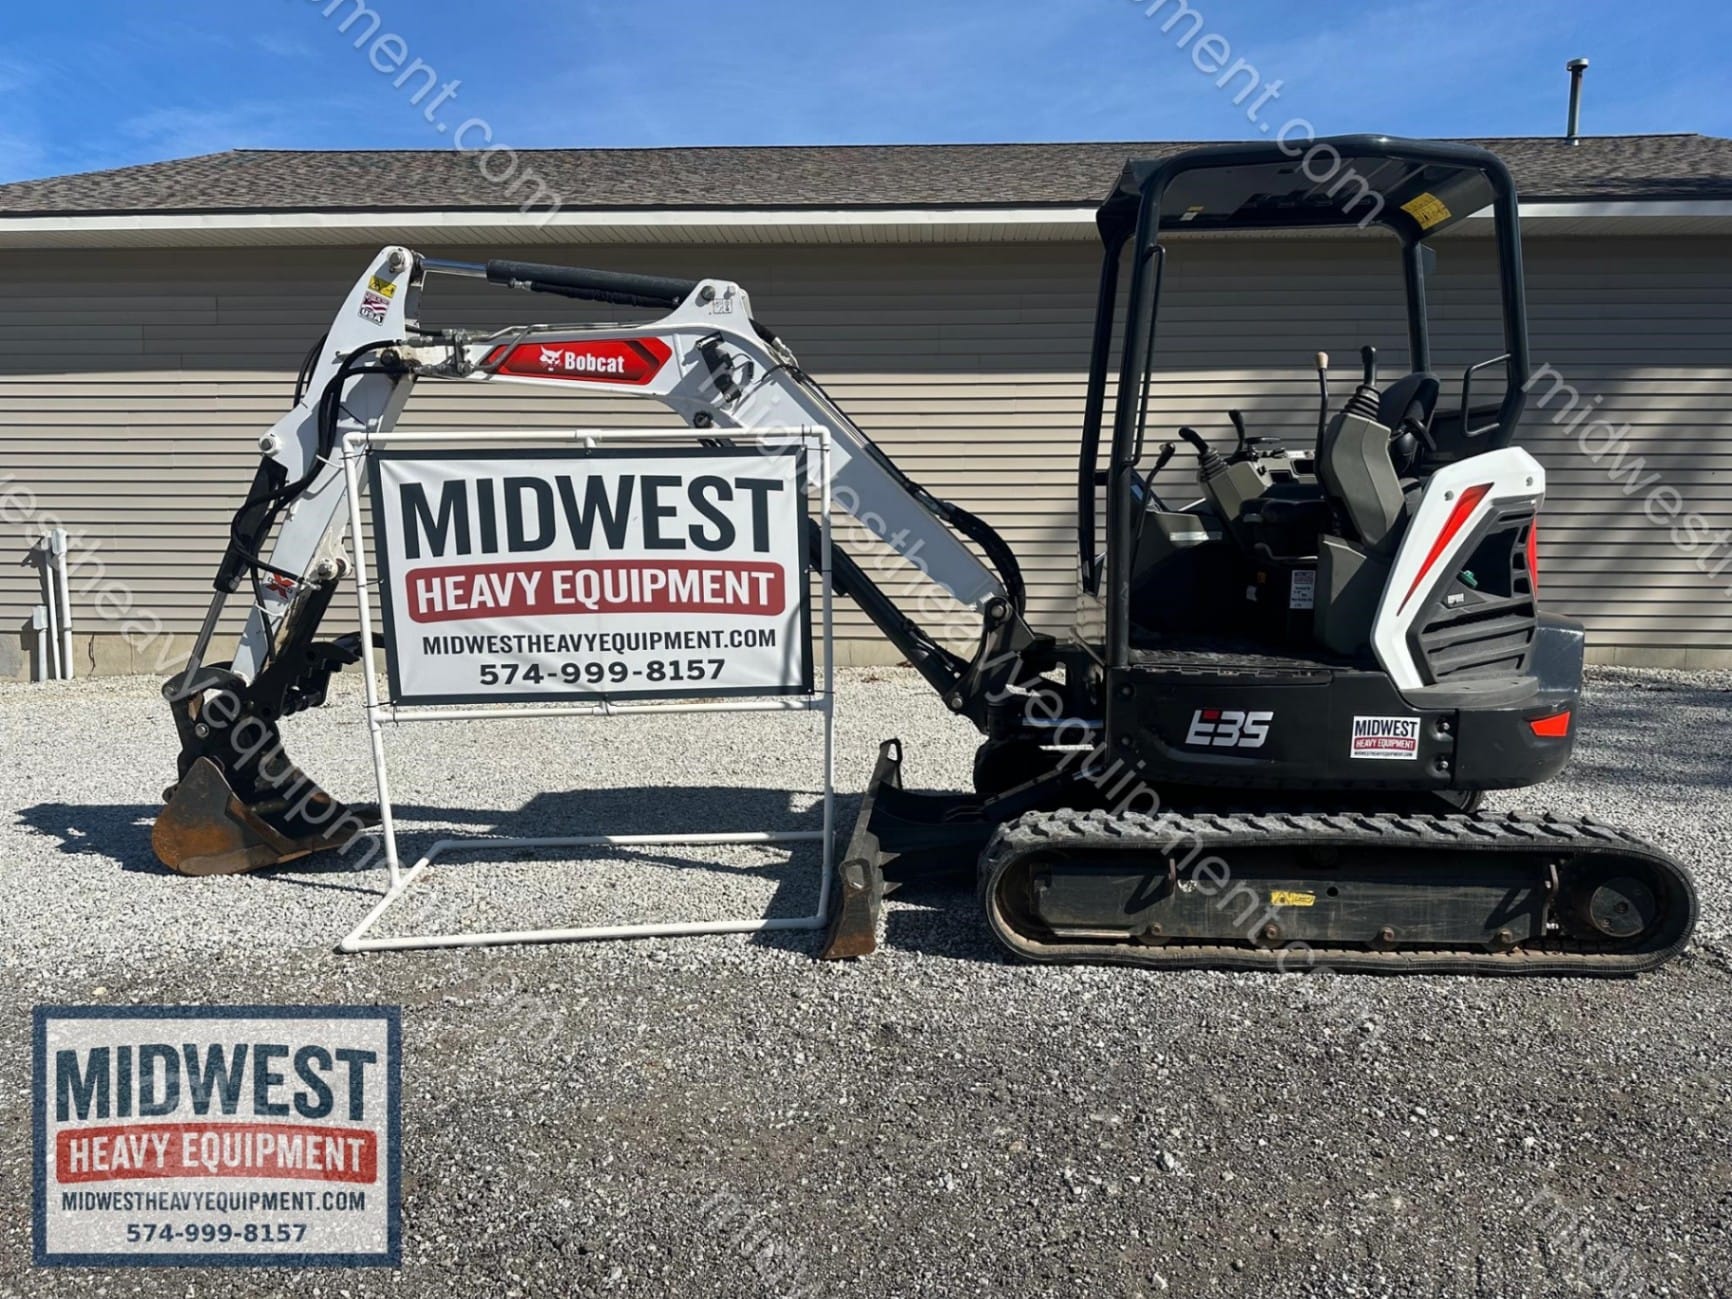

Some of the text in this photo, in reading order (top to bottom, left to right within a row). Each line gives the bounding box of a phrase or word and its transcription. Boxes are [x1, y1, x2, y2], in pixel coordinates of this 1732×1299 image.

[565, 351, 625, 373] Bobcat
[399, 475, 784, 559] MIDWEST
[416, 568, 775, 613] HEAVY EQUIPMENT
[423, 629, 776, 655] MIDWESTHEAVYEQUIPMENT.COM
[479, 658, 726, 685] 574-999-8157
[1185, 709, 1274, 748] E35
[1354, 719, 1418, 738] MIDWEST
[1355, 738, 1414, 749] HEAVY EQUIPMENT
